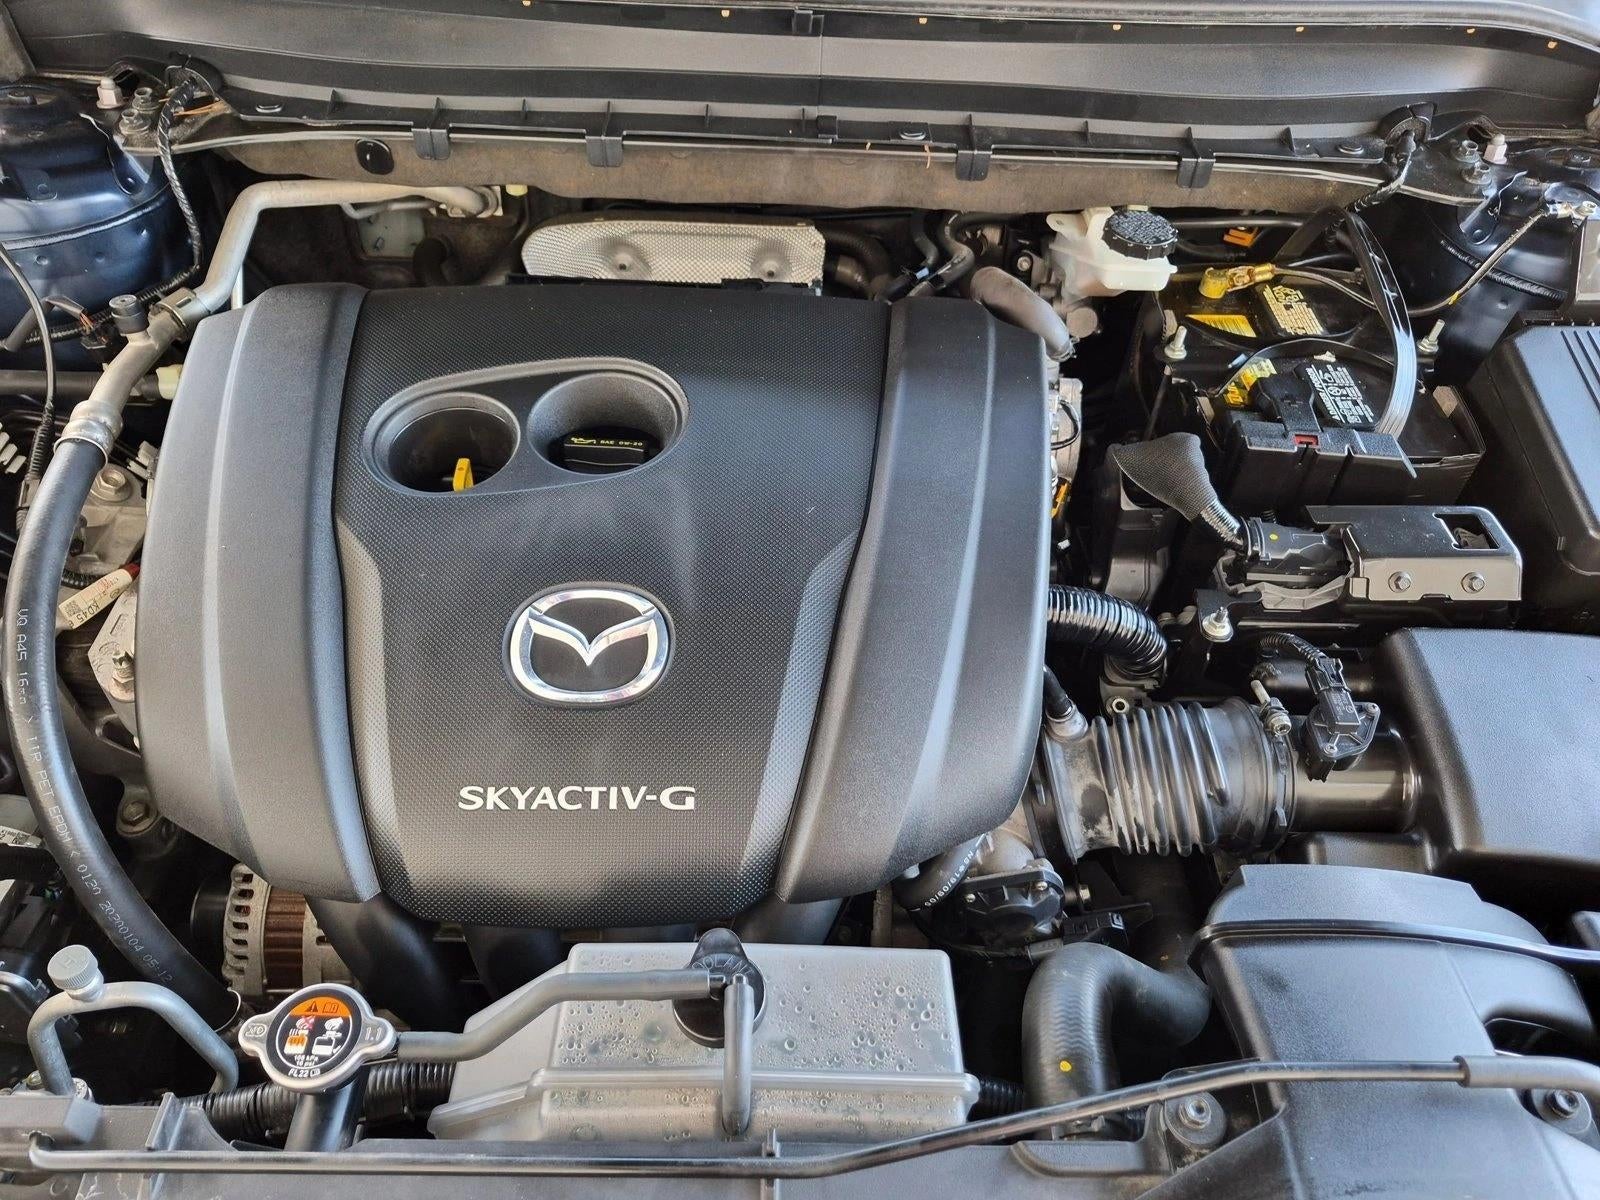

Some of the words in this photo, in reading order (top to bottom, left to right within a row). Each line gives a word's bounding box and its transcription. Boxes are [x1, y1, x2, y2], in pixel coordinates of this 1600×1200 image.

[77, 602, 100, 623] KD45
[16, 634, 28, 661] A45
[36, 770, 56, 798] PET
[48, 805, 73, 843] EPDM
[457, 785, 696, 811] SKYACTIV-G
[287, 1068, 308, 1077] FL22
